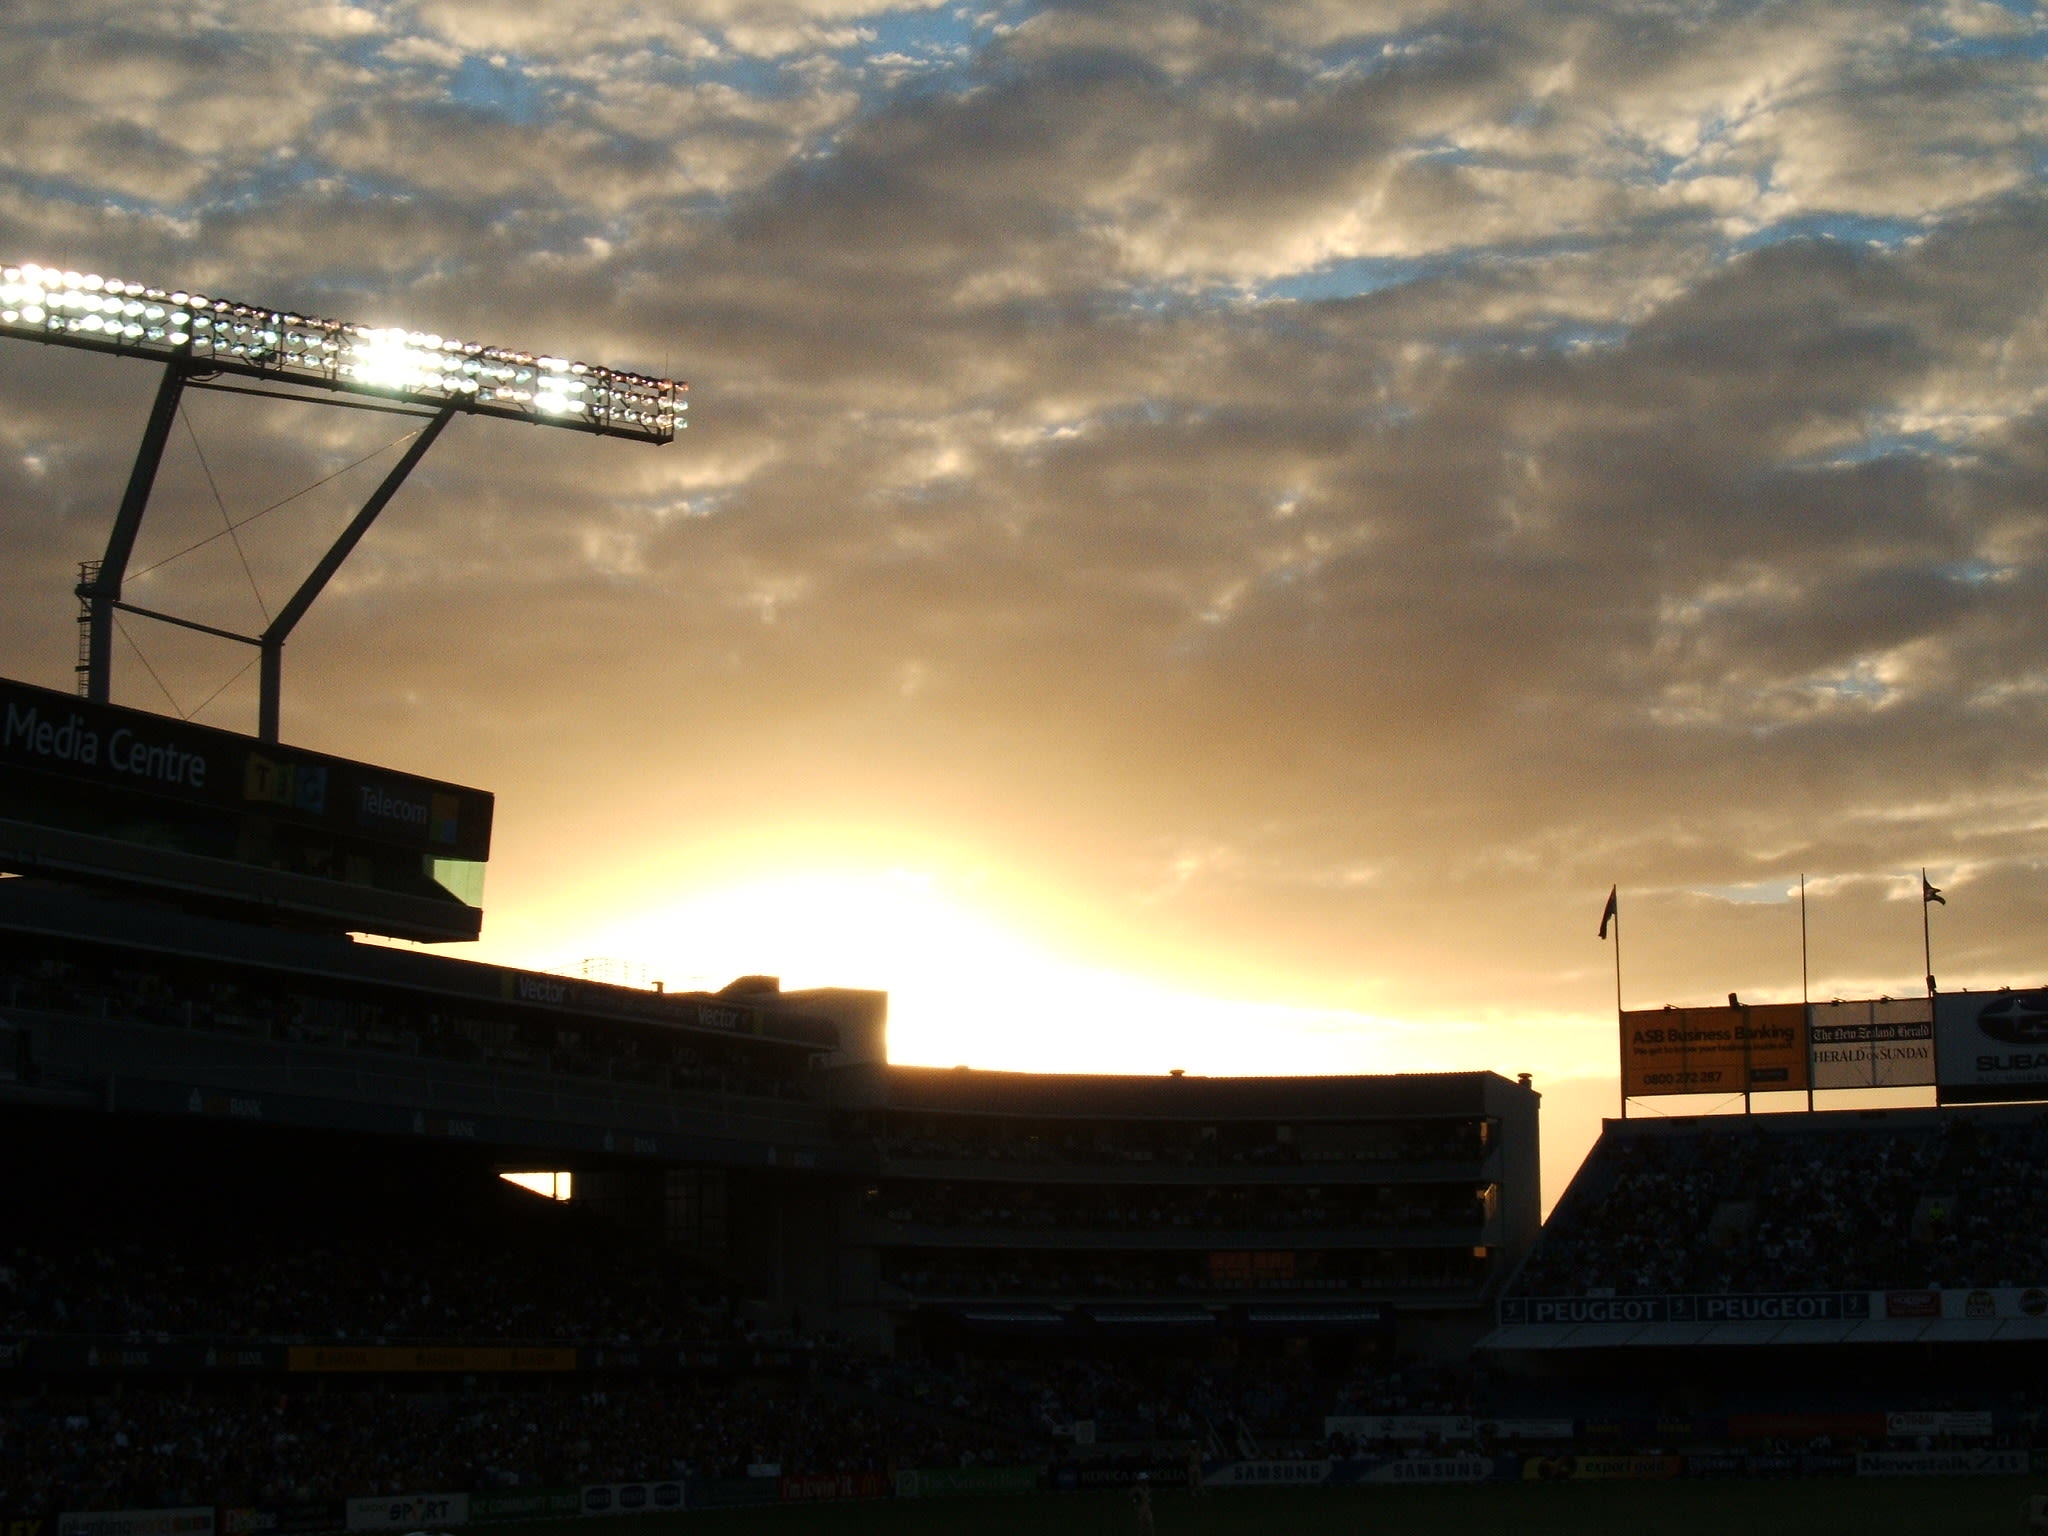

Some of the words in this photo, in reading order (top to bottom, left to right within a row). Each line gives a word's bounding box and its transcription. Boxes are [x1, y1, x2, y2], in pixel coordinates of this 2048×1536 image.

[4, 702, 99, 765] Media
[109, 728, 207, 788] Centre
[358, 785, 429, 825] Telecom
[519, 976, 566, 1004] Vector
[697, 1005, 739, 1030] Vector
[1633, 1030, 1665, 1043] ASB
[1668, 1028, 1731, 1042] Business
[1734, 1024, 1795, 1041] Banking
[1813, 1029, 1832, 1041] The
[1834, 1028, 1857, 1040] New
[1858, 1025, 1895, 1039] Zealand
[1896, 1024, 1930, 1038] Herald
[1814, 1048, 1865, 1063] HERALD
[1879, 1047, 1929, 1061] SUNDAY
[1643, 1073, 1674, 1085] 0800
[1676, 1072, 1698, 1084] 272
[1536, 1300, 1658, 1321] PEUGEOT
[1706, 1297, 1833, 1318] PEUGEOT
[1392, 1461, 1483, 1479] SAMSUNG
[1585, 1460, 1631, 1476] export
[1861, 1454, 1971, 1471] Newstalk
[1081, 1470, 1130, 1482] KONICA
[1233, 1463, 1321, 1481] SAMSUNG
